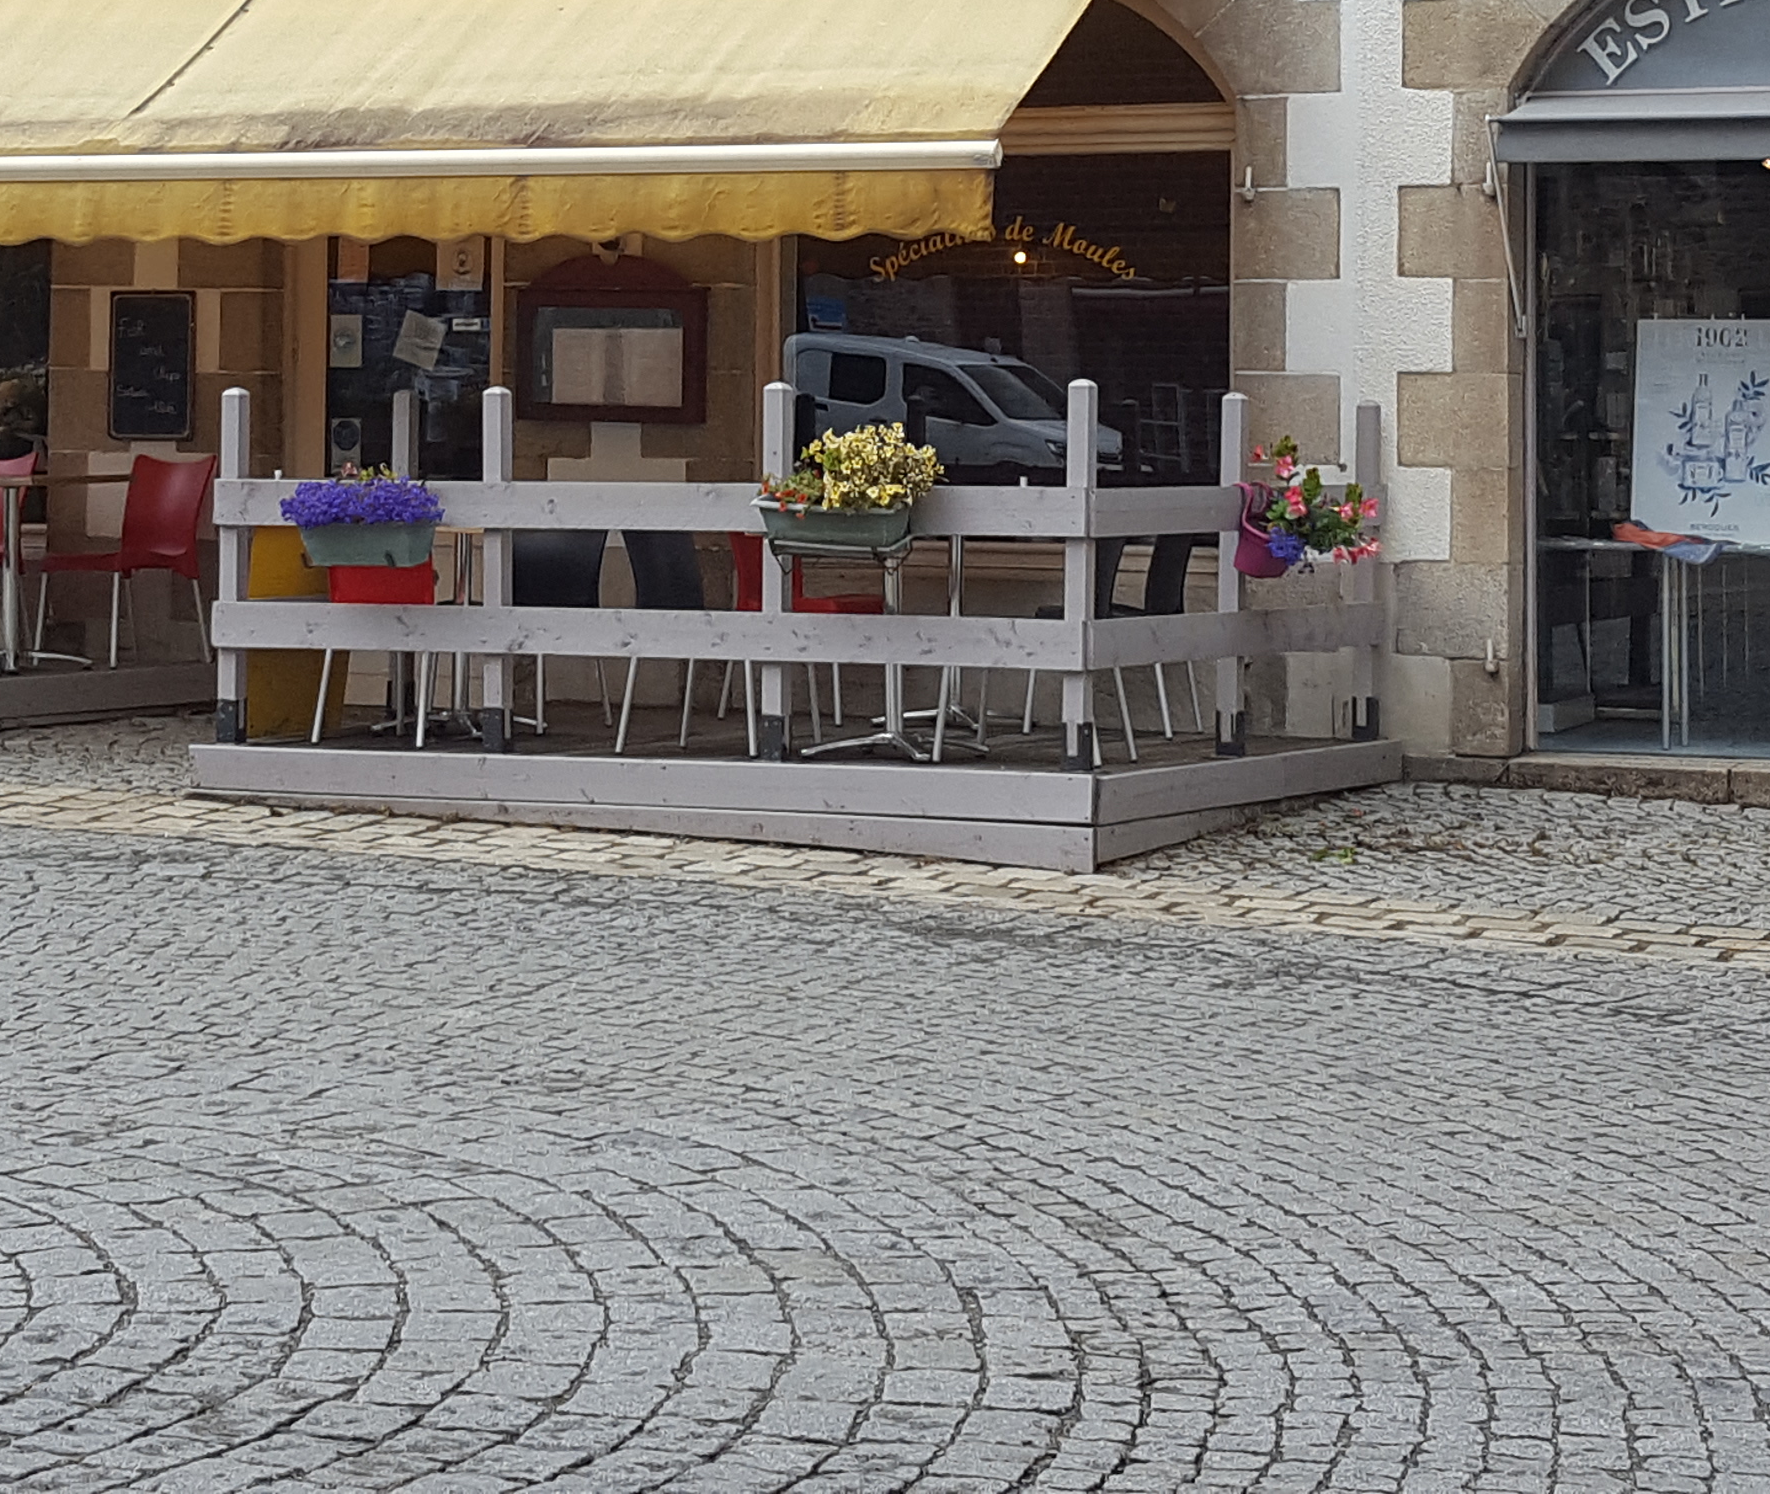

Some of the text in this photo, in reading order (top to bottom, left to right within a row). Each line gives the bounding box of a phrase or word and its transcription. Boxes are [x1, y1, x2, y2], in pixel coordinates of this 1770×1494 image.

[1004, 215, 1035, 242] de
[1042, 221, 1136, 281] Moules
[1695, 326, 1749, 348] 1902
